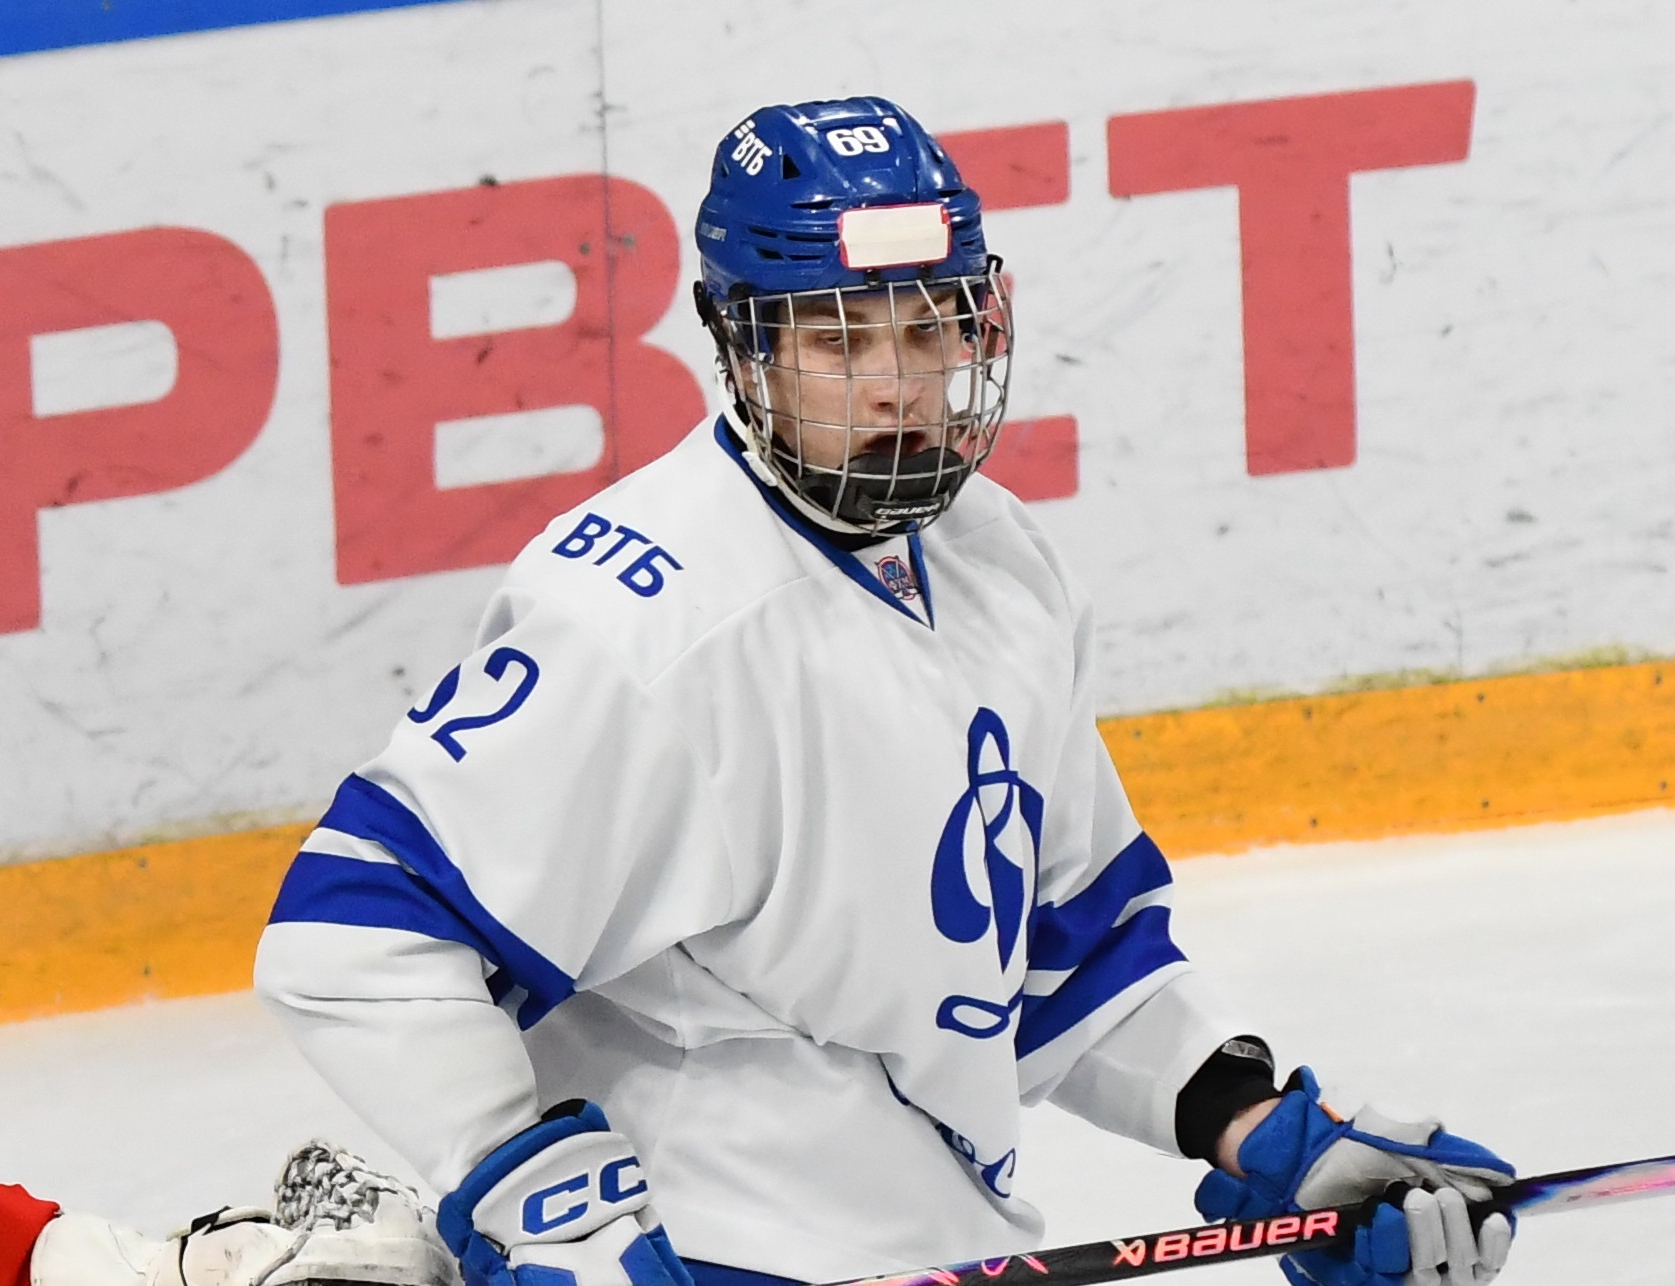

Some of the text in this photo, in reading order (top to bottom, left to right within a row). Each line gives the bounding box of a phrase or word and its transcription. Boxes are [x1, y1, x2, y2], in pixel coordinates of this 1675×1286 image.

[731, 131, 773, 176] ВТБ
[825, 125, 890, 157] 69
[551, 512, 685, 598] ВТБ
[522, 1155, 650, 1236] CC
[1153, 1210, 1339, 1264] BAUER
